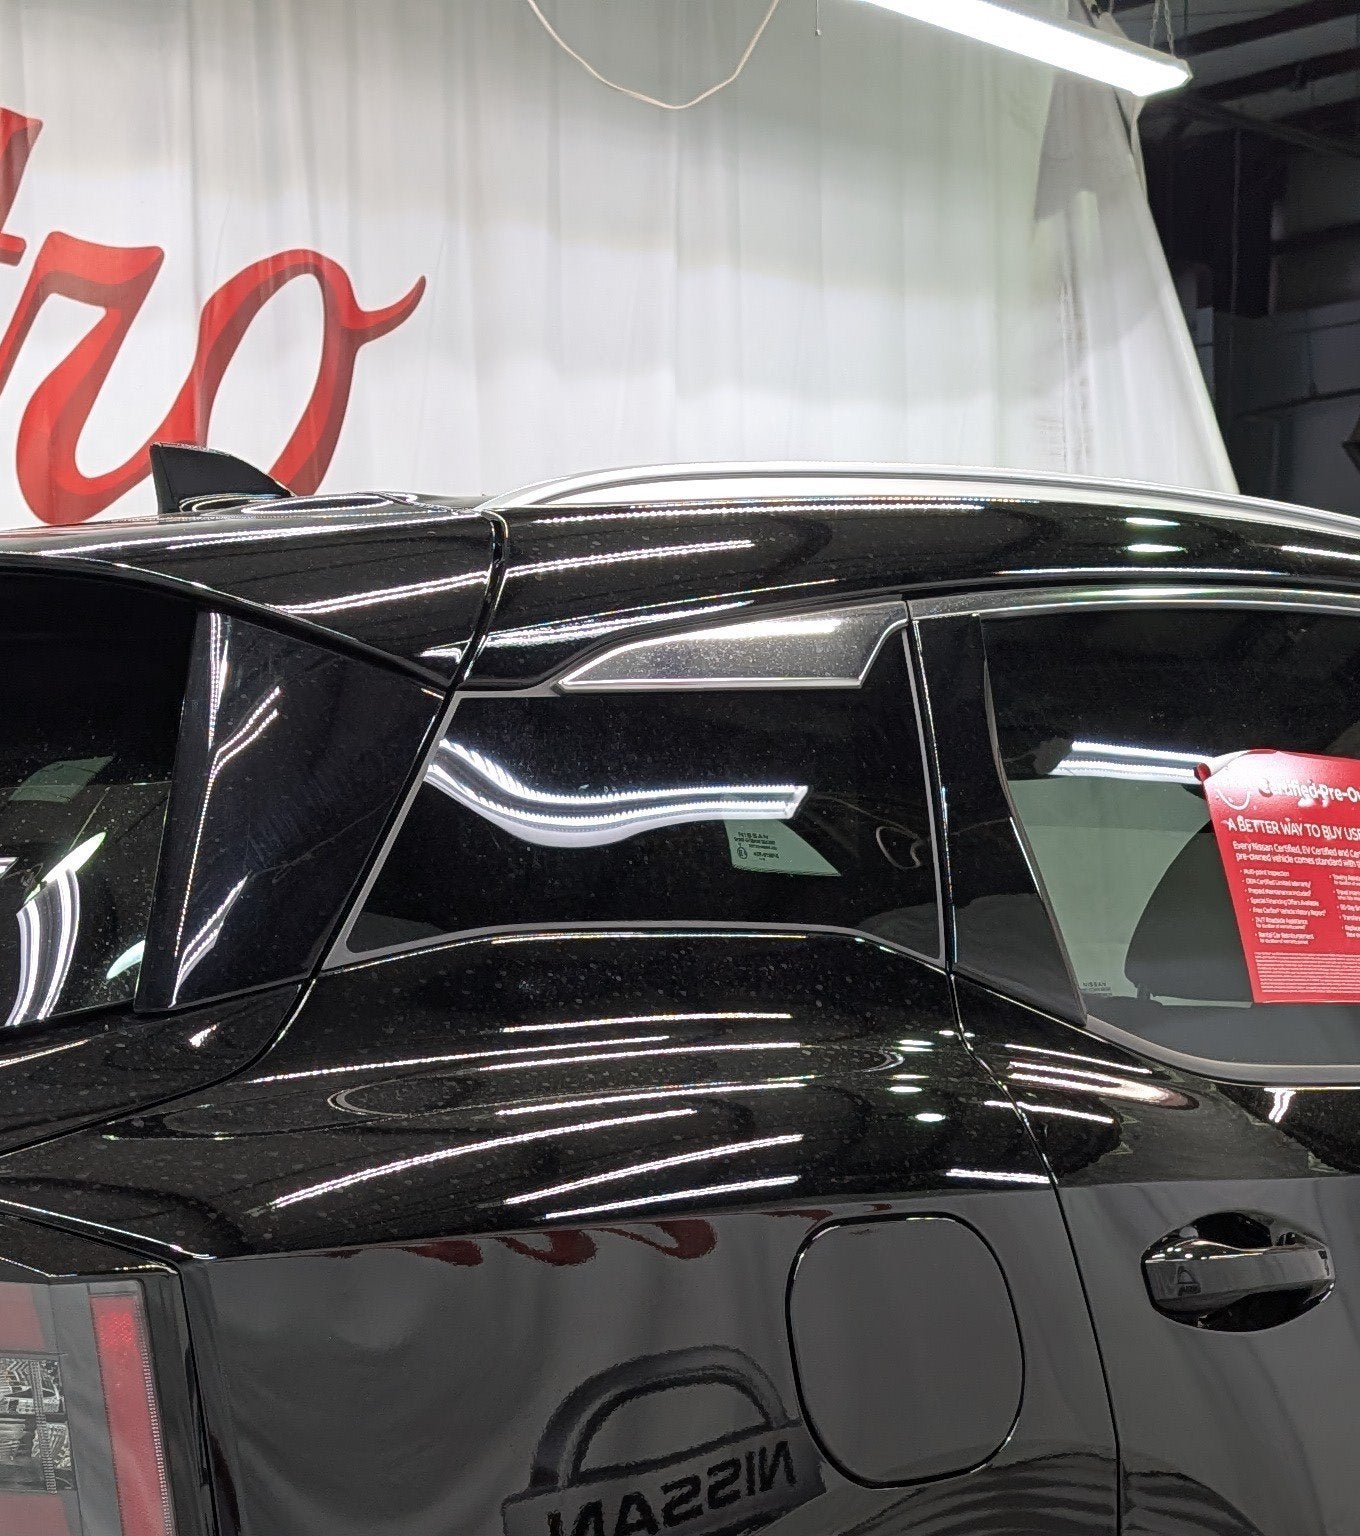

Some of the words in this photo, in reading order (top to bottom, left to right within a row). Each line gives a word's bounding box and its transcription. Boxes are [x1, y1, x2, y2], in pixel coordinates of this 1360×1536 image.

[1237, 817, 1280, 835] BETTER
[1281, 821, 1303, 837] WAY
[1304, 823, 1321, 838] TO
[1322, 825, 1343, 840] BUY
